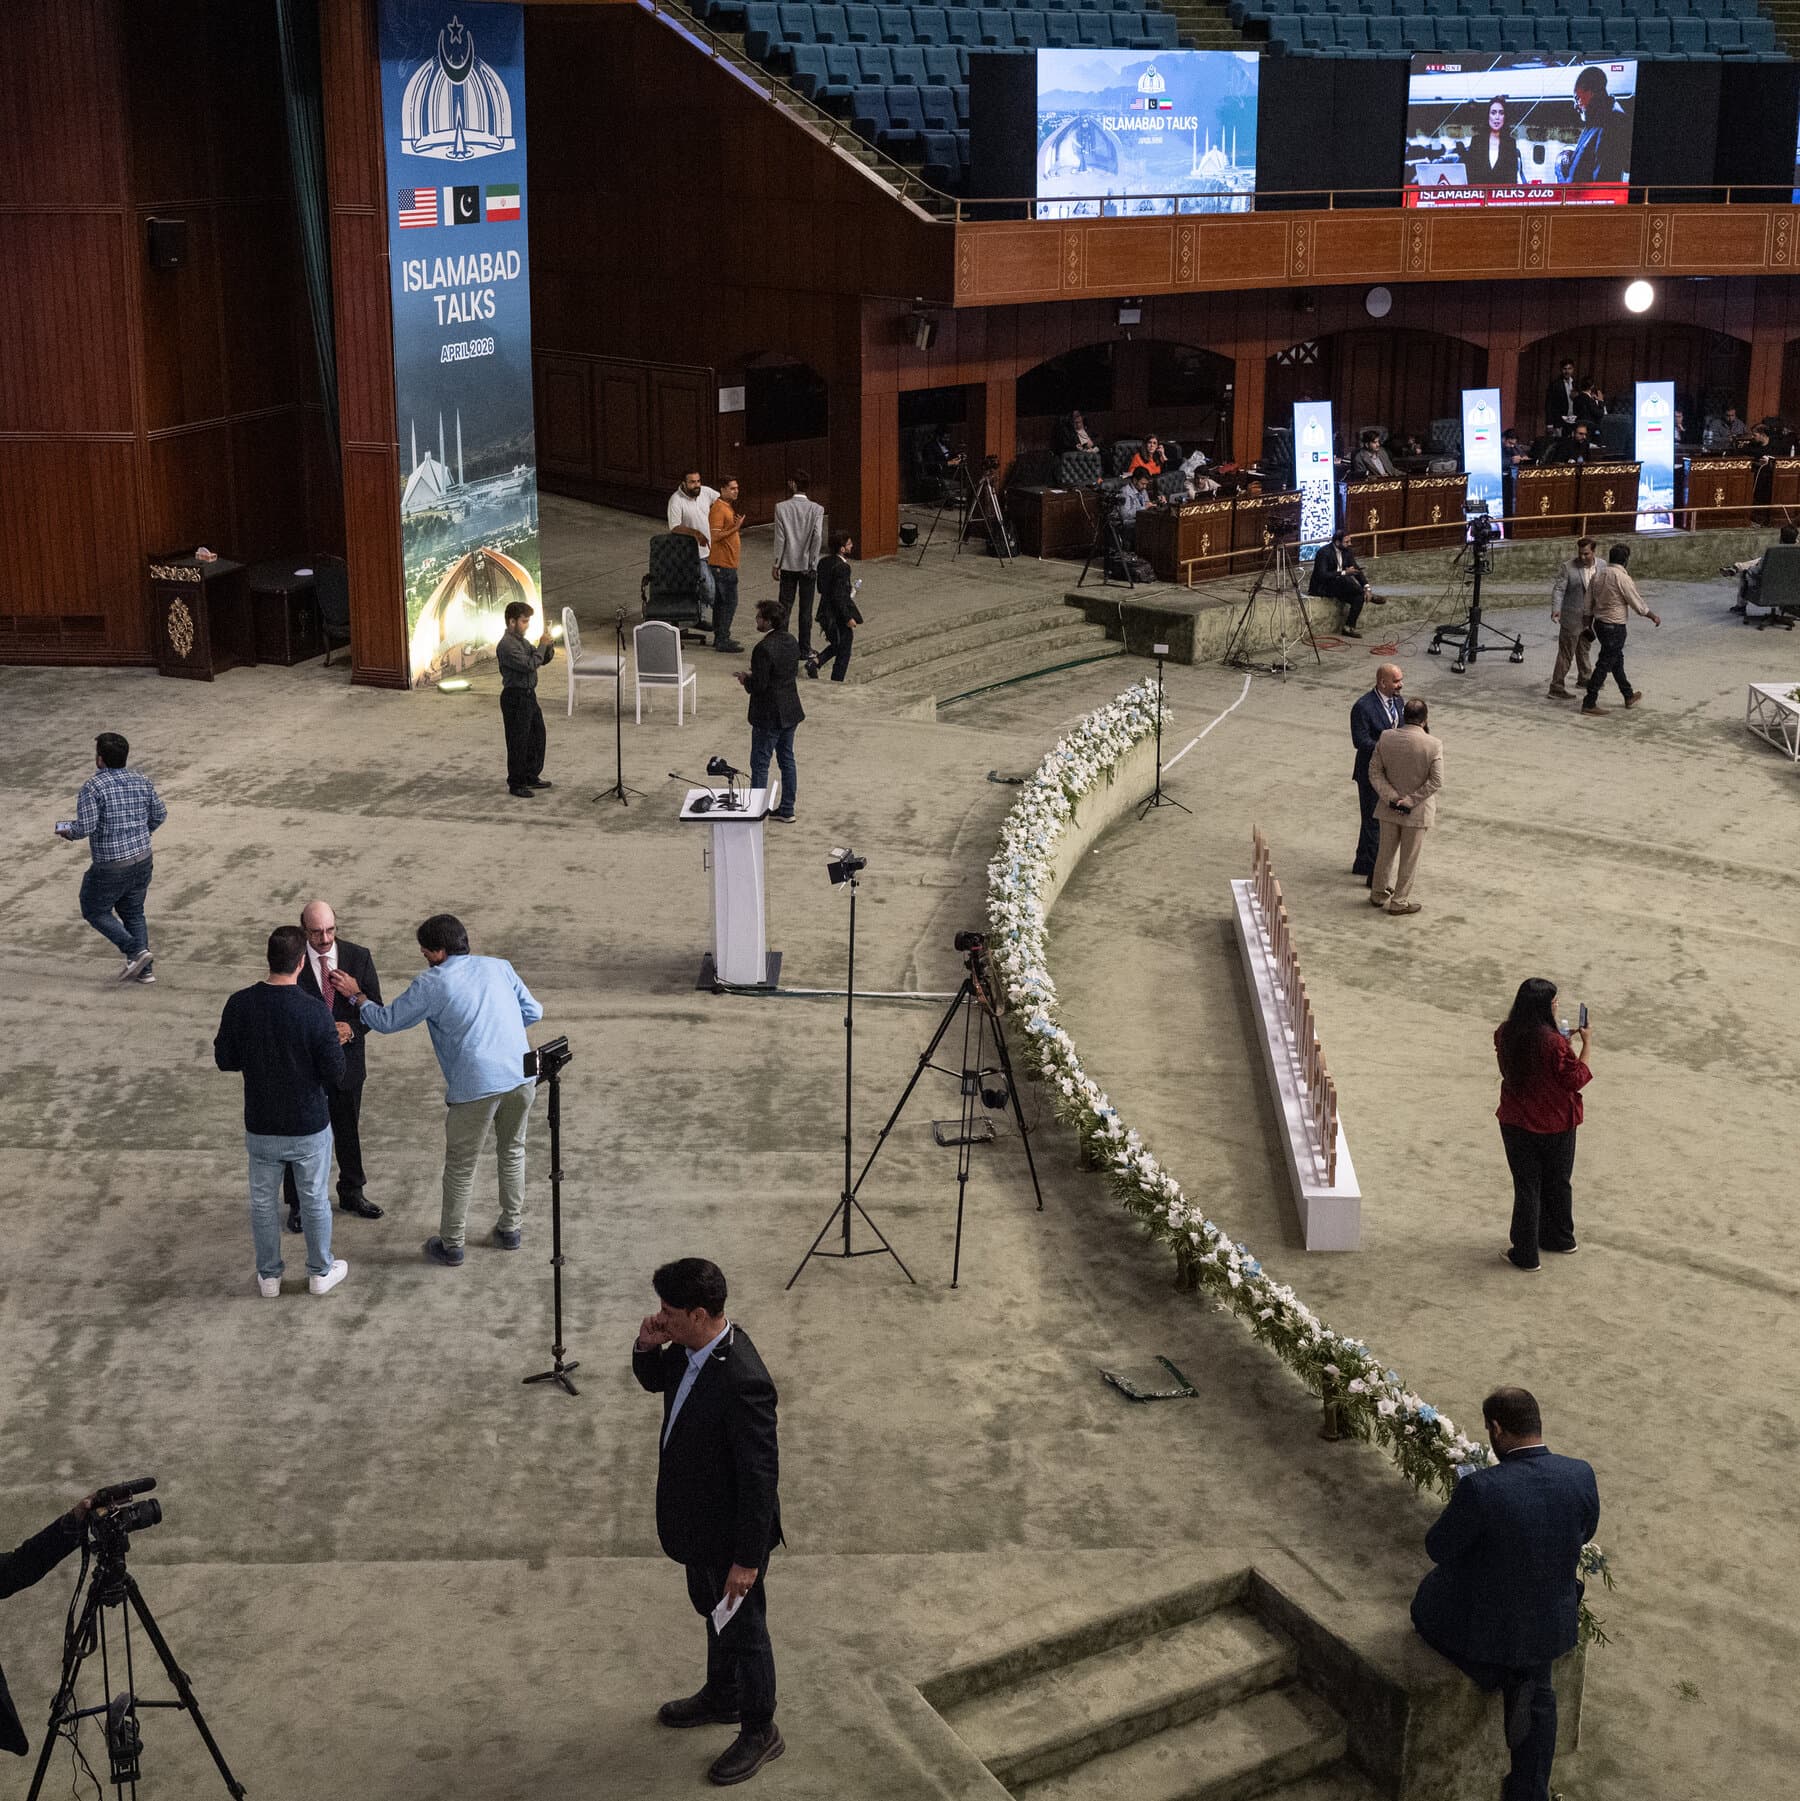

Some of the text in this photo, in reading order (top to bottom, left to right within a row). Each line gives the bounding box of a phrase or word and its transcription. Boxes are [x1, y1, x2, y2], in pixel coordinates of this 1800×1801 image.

[1103, 116, 1198, 131] ISLAMABAD TALKS
[1491, 189, 1525, 199] TALKS
[1527, 188, 1554, 198] 2026
[402, 250, 521, 292] ISLAMABAD
[434, 288, 496, 326] TALKS
[440, 337, 495, 363] APRIL 2026
